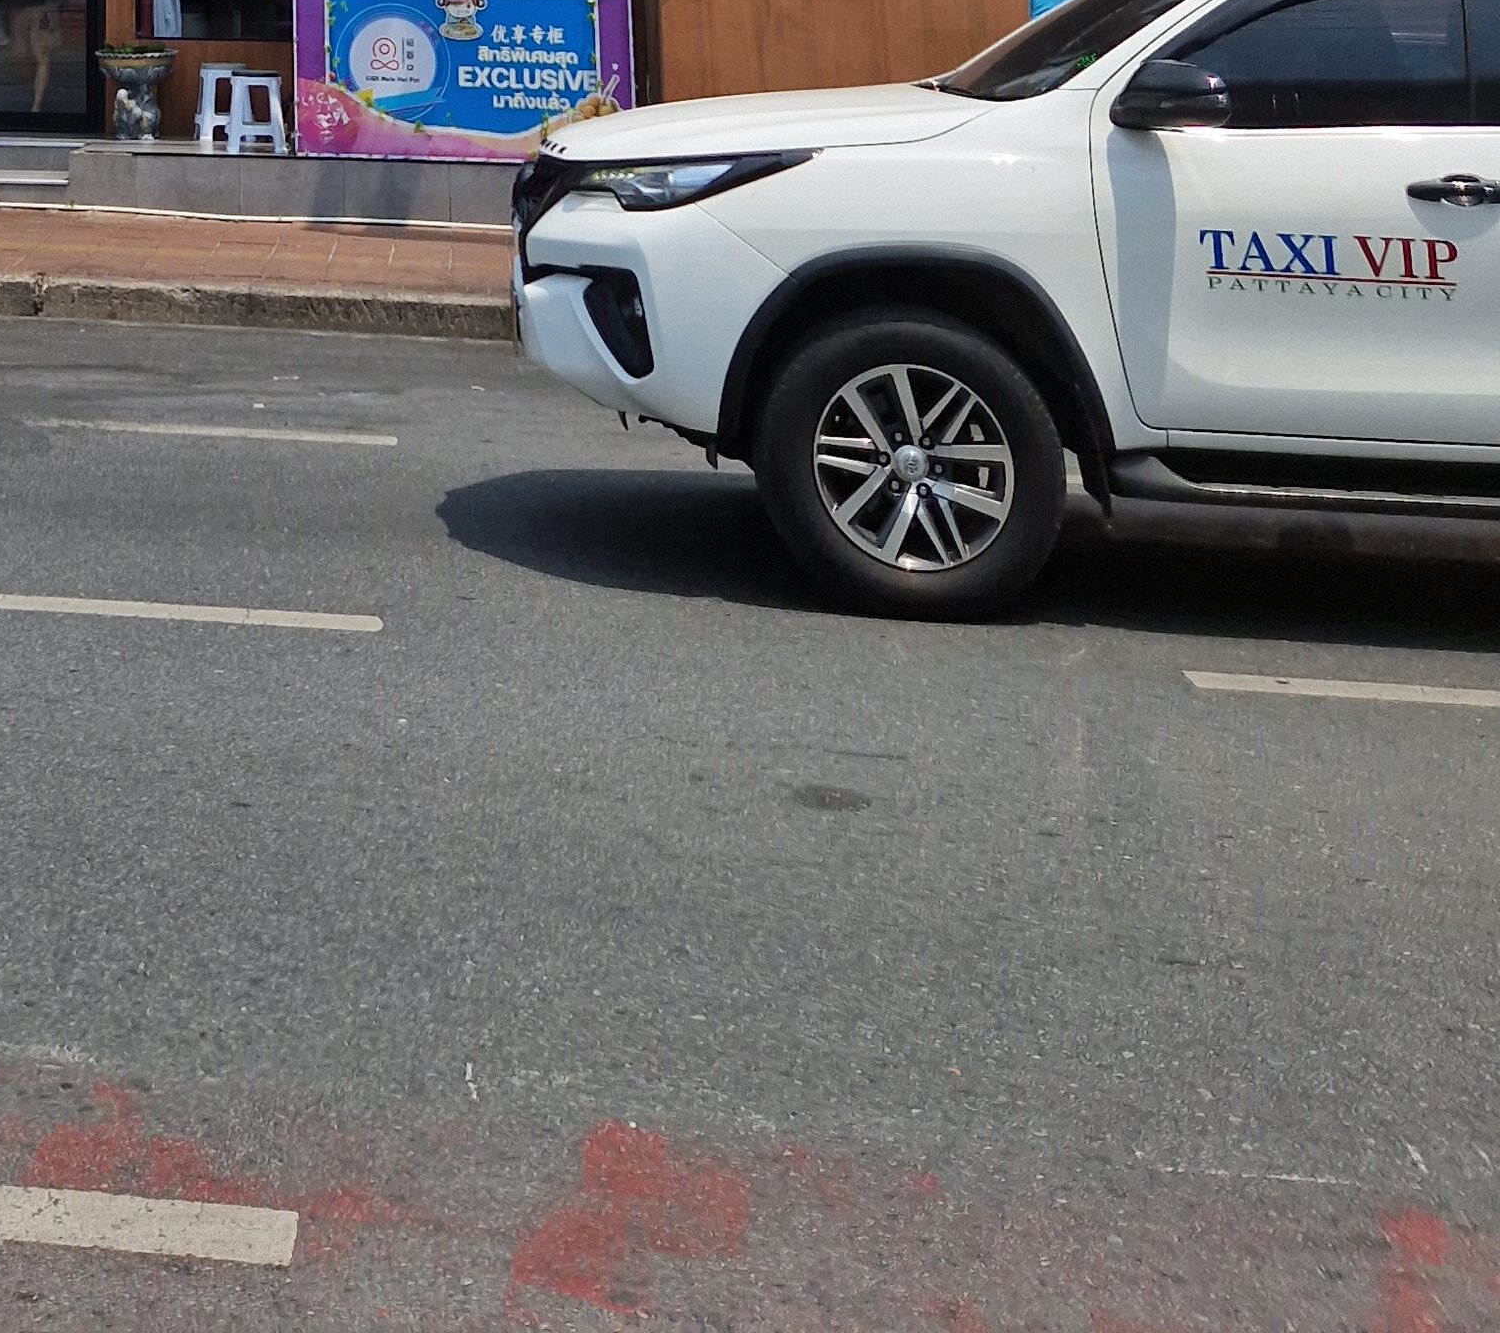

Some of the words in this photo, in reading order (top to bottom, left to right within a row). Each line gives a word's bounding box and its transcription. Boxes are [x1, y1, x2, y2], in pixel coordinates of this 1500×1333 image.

[490, 23, 566, 45] 优享专柜
[458, 65, 599, 92] EXCLUSIVE
[1199, 229, 1342, 276] TAXI
[1352, 235, 1459, 281] VIP
[1206, 276, 1364, 297] PATTAYA
[1375, 285, 1456, 302] CITY
